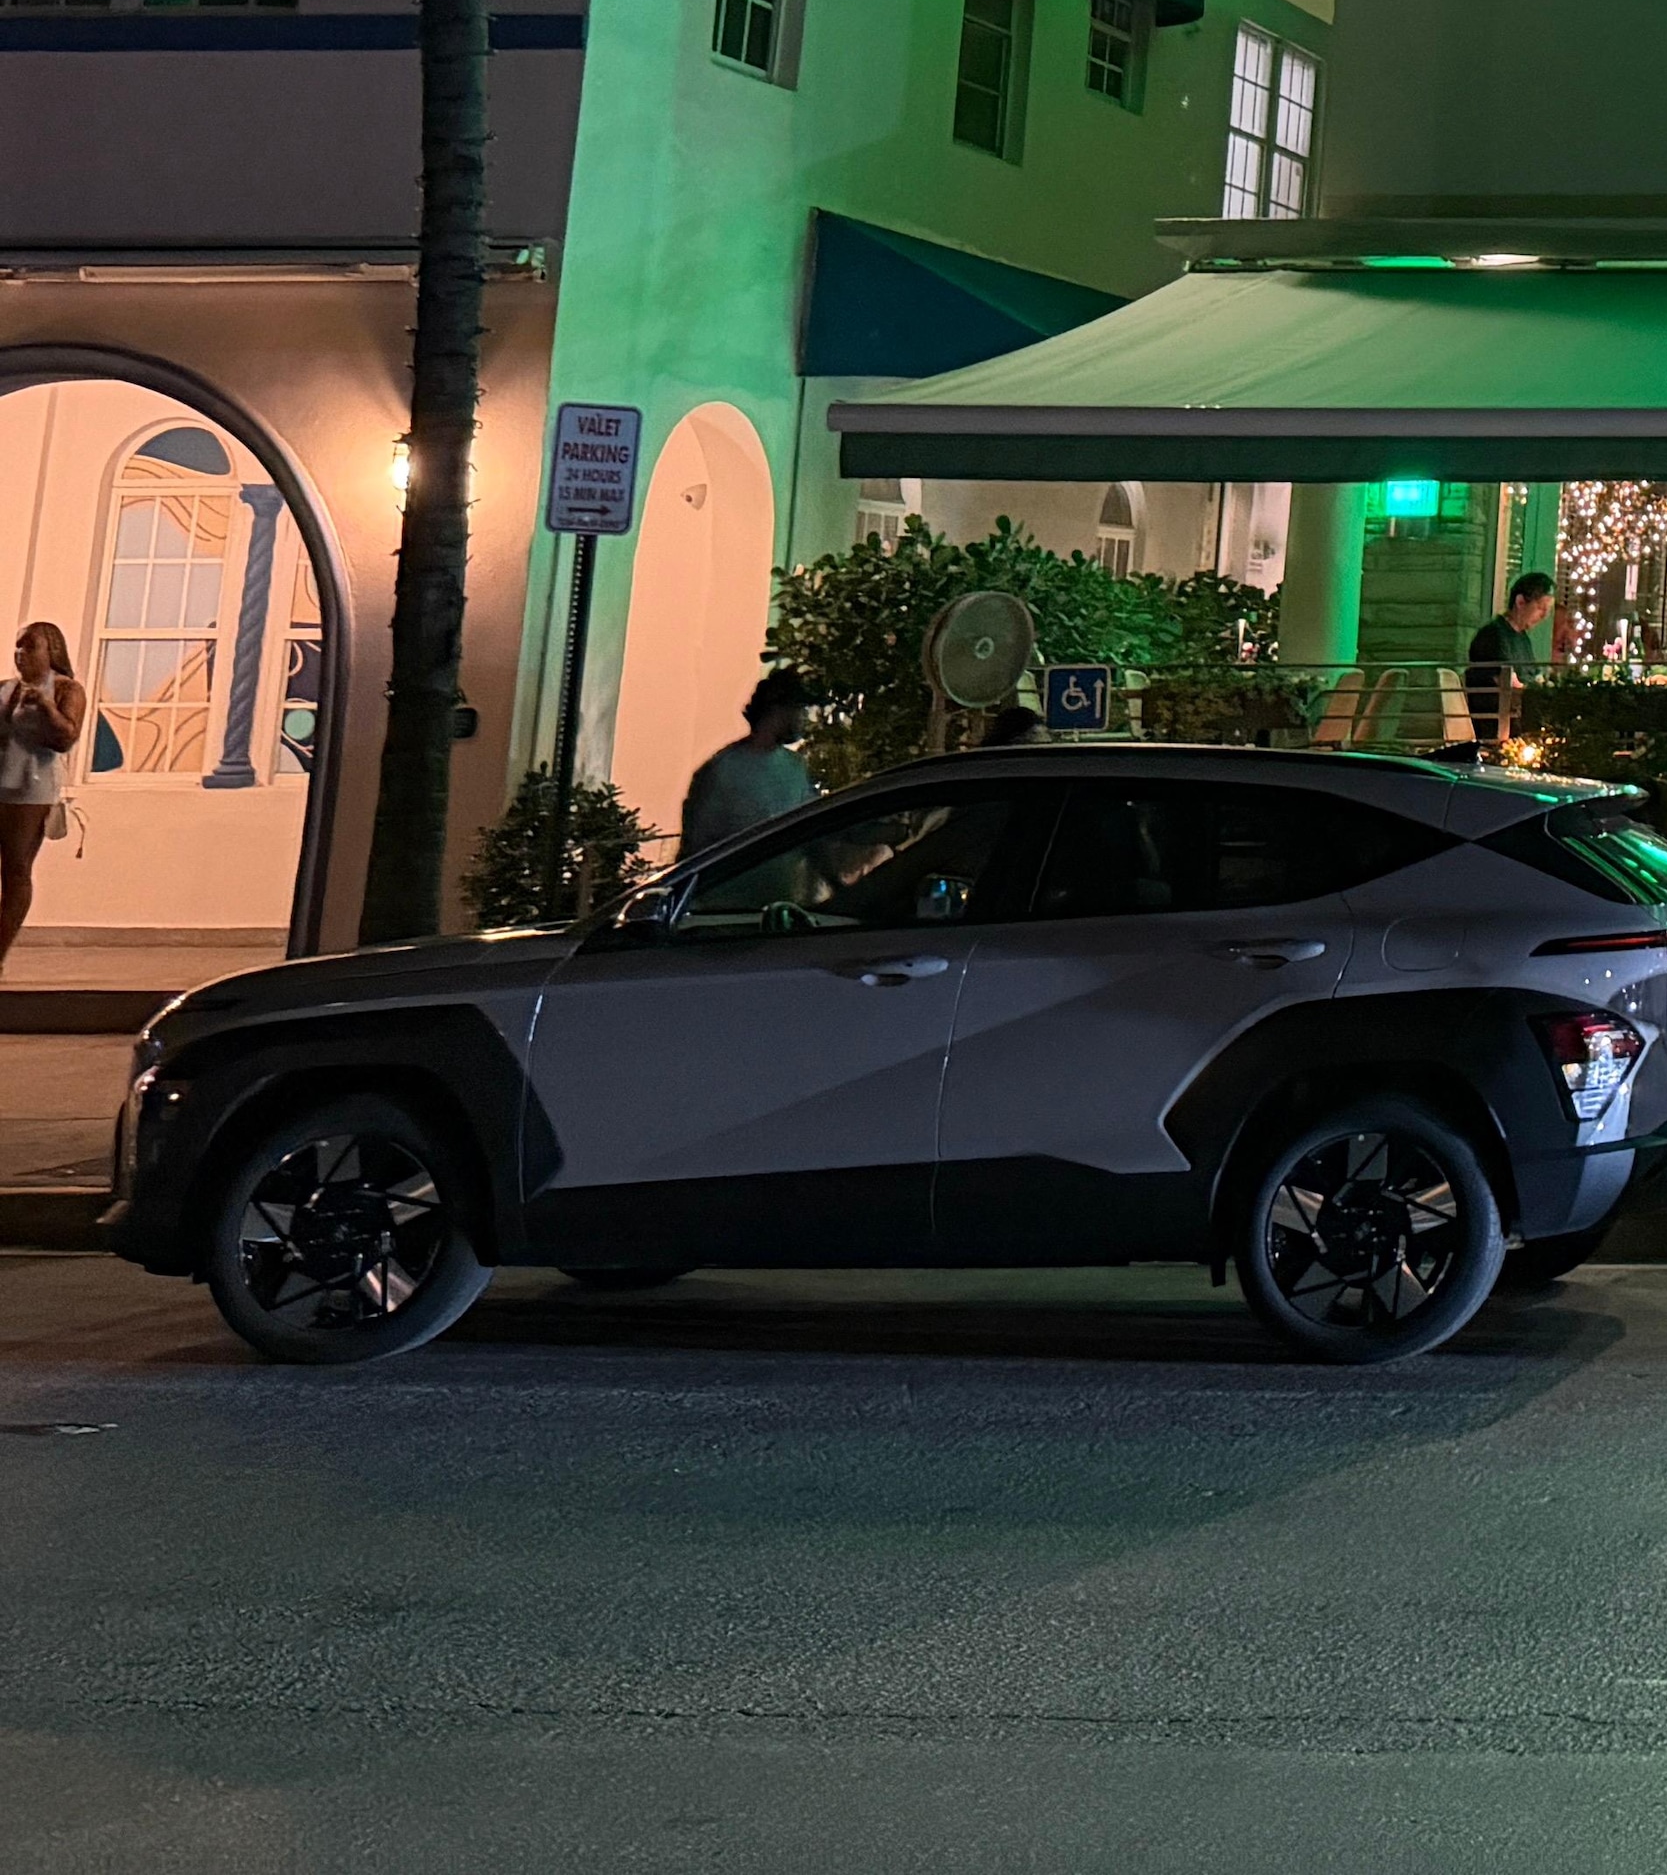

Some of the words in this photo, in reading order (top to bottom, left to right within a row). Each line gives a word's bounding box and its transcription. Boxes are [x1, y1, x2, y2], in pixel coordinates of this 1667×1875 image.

[577, 416, 621, 436] VALET
[562, 442, 629, 463] PARKING
[582, 469, 621, 483] HOURS
